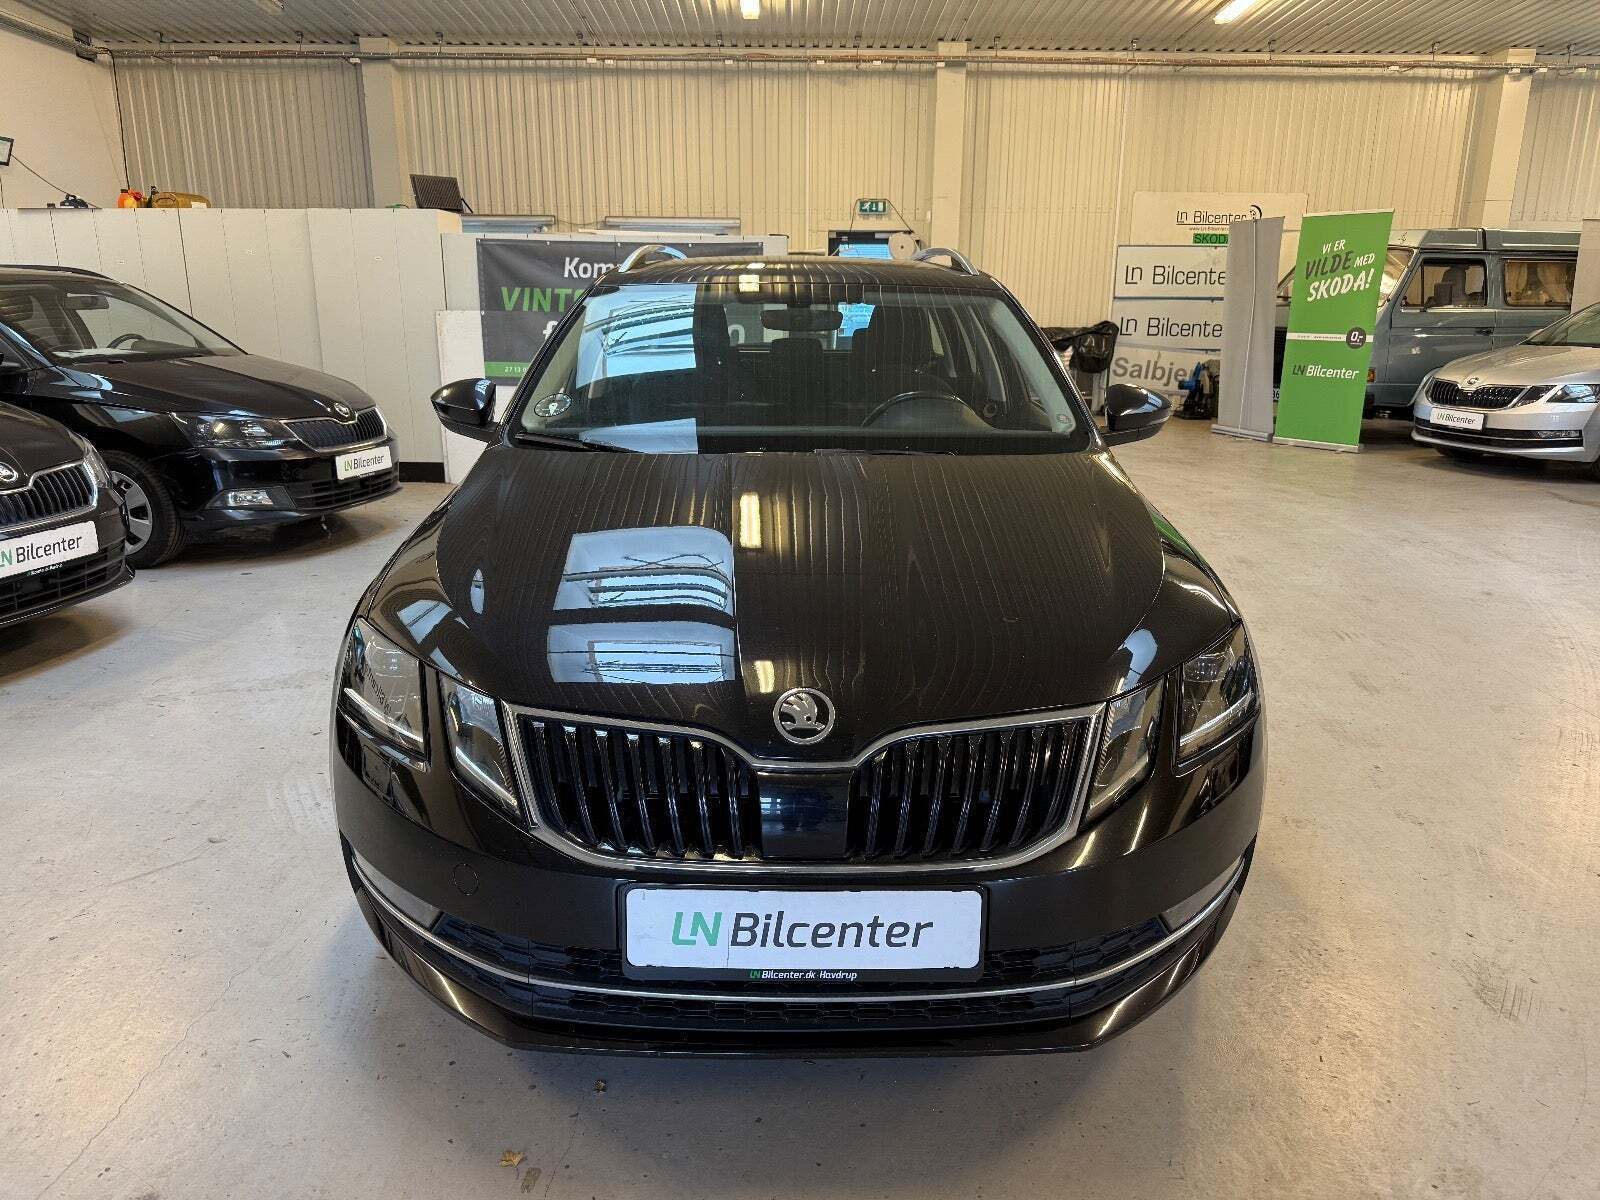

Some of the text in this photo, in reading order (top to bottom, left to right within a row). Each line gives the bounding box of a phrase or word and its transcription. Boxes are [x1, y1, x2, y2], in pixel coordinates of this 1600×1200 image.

[1193, 210, 1247, 224] Bilcenter
[1193, 233, 1228, 245] SKOD
[1322, 239, 1346, 255] VI ER
[563, 256, 621, 279] Kom
[1152, 265, 1227, 286] Bilcente
[1305, 250, 1375, 280] VILDE MED
[1306, 268, 1375, 303] SKODA!
[1146, 317, 1223, 338] Bilcente
[1111, 356, 1192, 387] Salbje
[1305, 364, 1360, 380] Bilcenter
[1445, 413, 1476, 425] Bilcenter
[344, 455, 385, 472] LN Bilcenter
[15, 536, 83, 564] Bilcenter
[671, 910, 934, 949] LN Bilcenter
[761, 970, 816, 979] Bilcenter.dk
